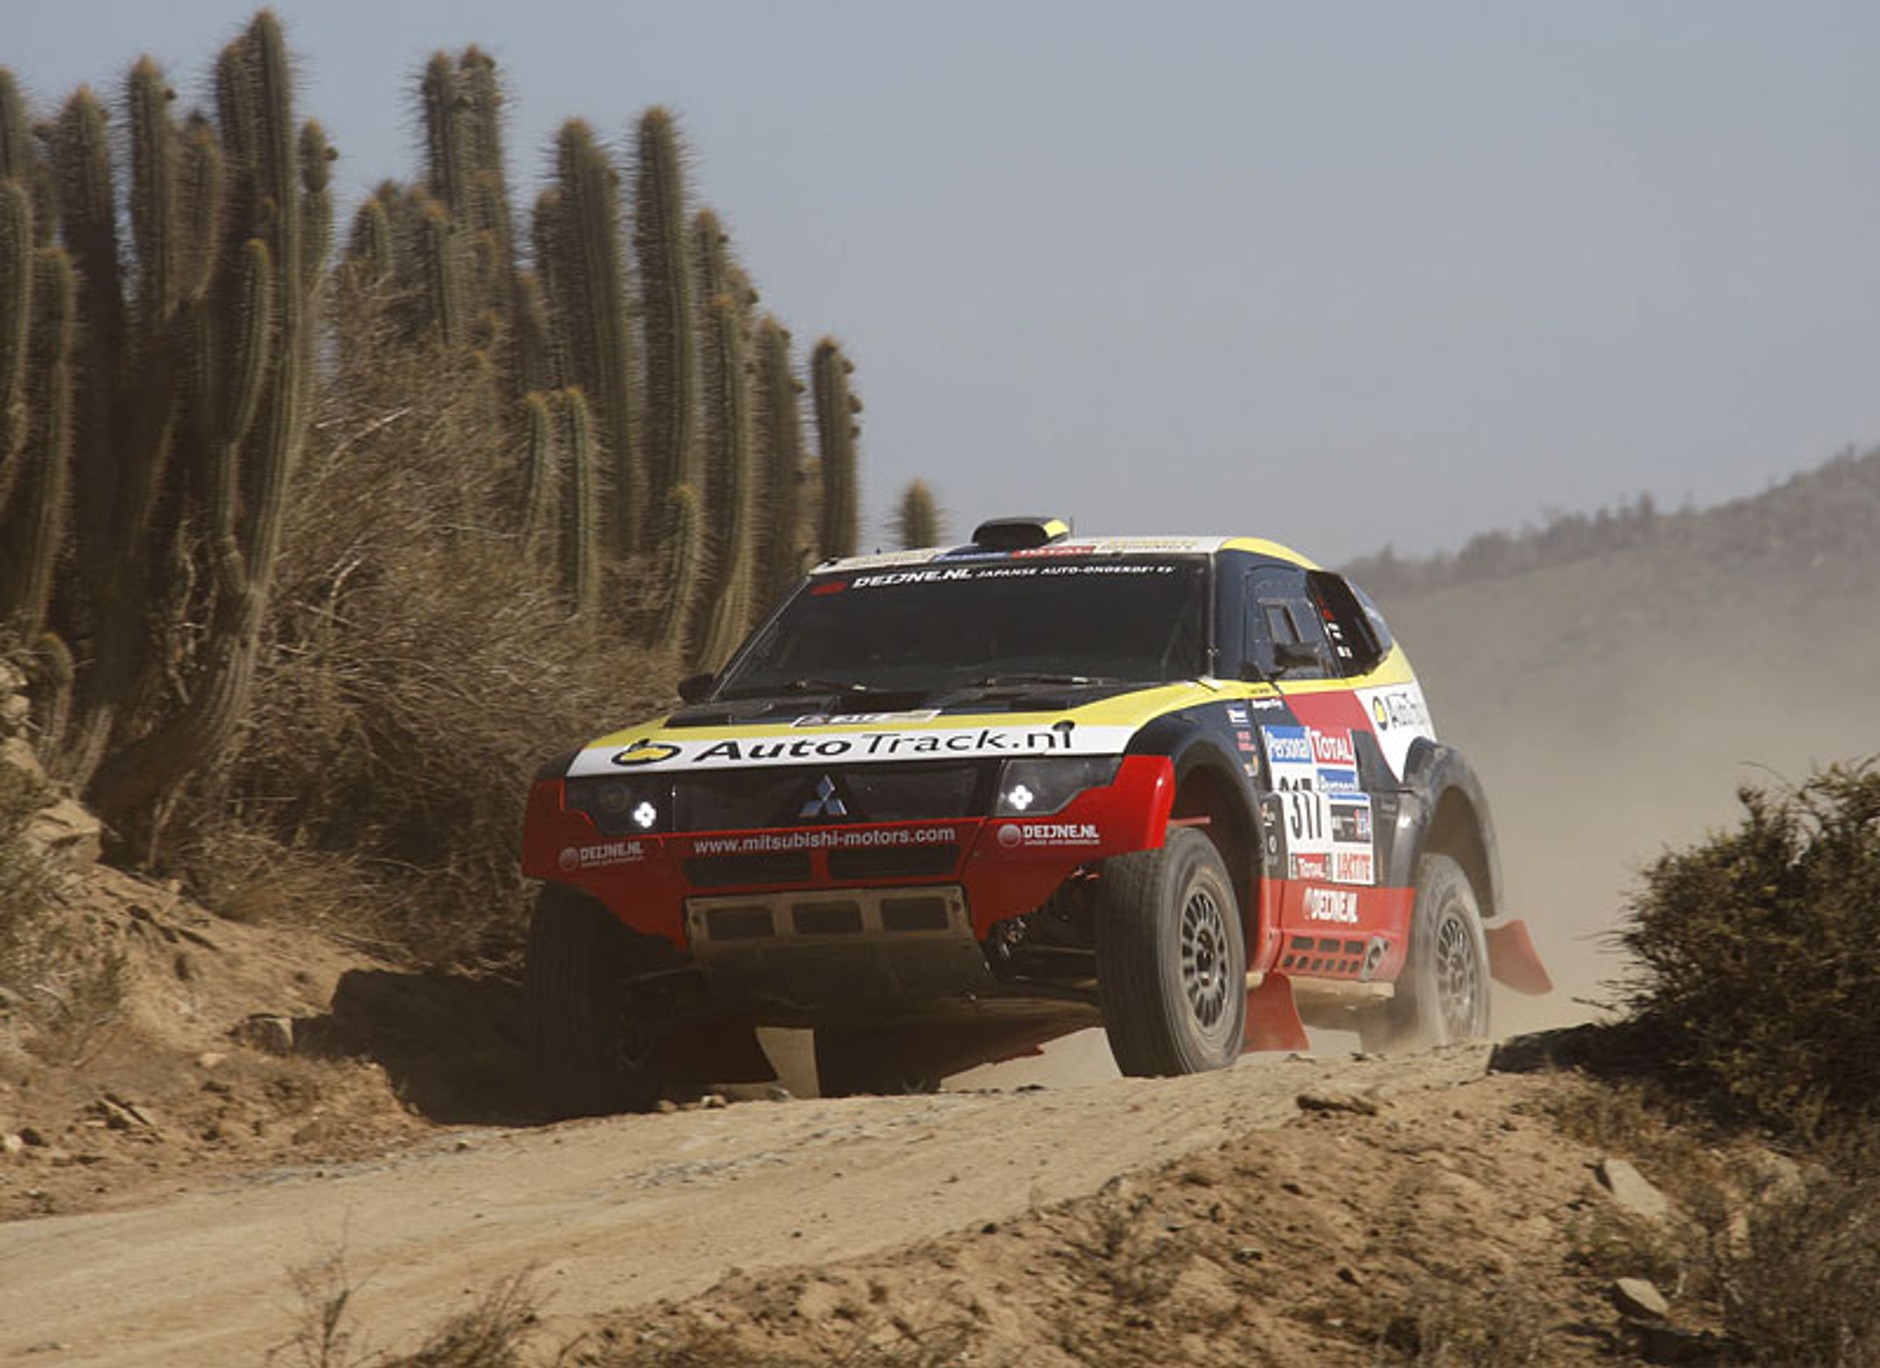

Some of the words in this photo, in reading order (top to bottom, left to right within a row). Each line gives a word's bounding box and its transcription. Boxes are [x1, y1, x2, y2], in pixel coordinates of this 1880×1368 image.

[852, 567, 972, 590] DEIJNE.NL
[1311, 730, 1355, 761] TOTAL
[693, 826, 956, 854] www.mitsubishi-motors.com
[1023, 823, 1100, 839] DEIJNE.NL
[580, 840, 645, 861] DEIJNE.NL
